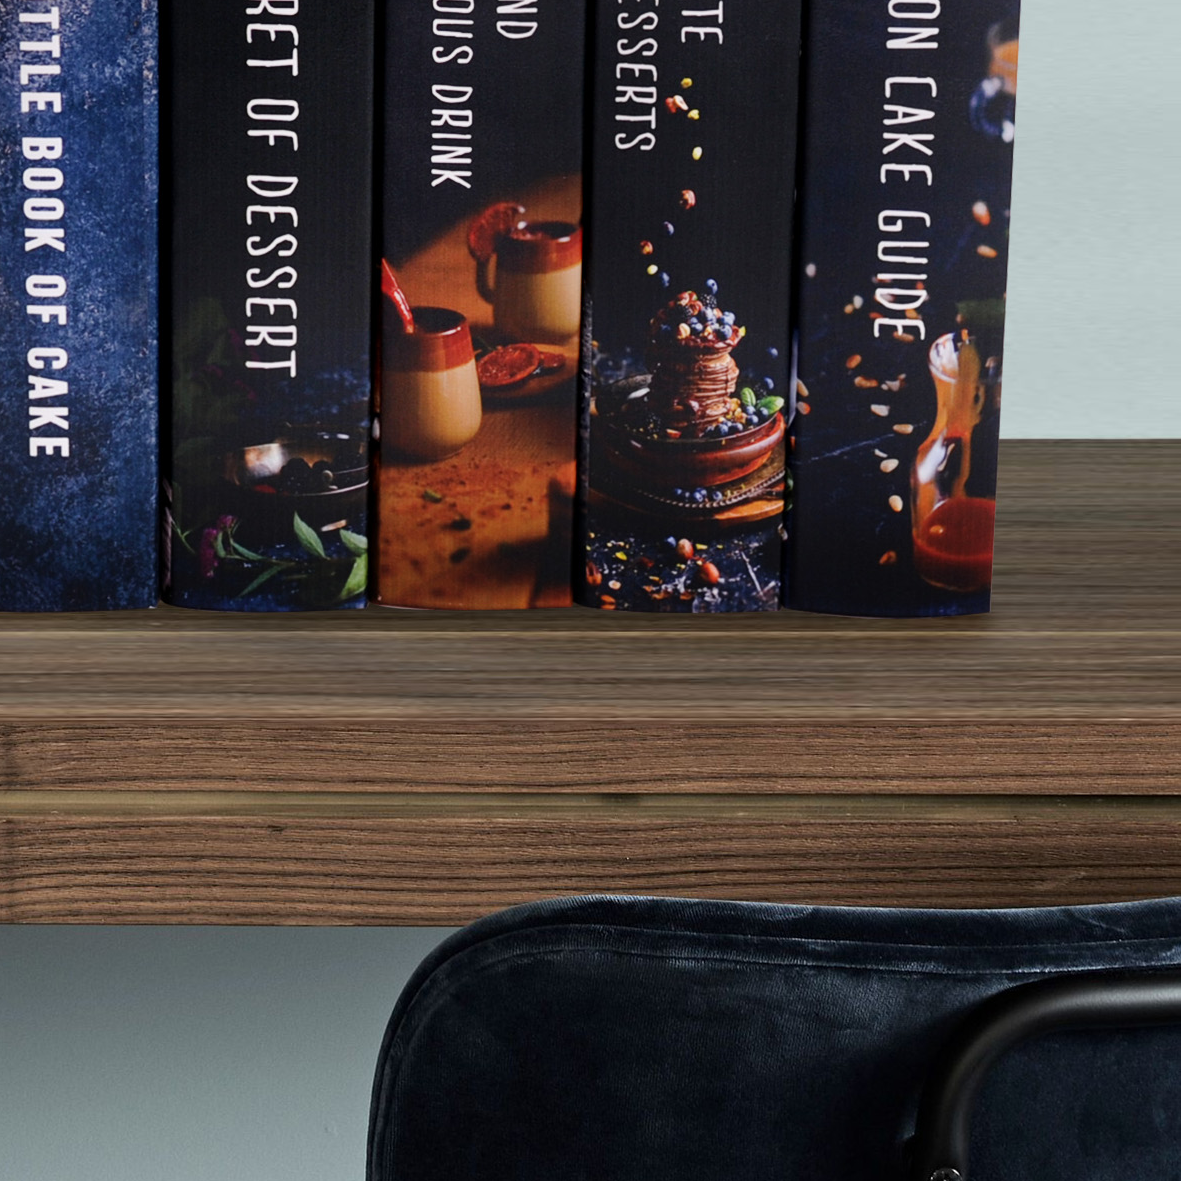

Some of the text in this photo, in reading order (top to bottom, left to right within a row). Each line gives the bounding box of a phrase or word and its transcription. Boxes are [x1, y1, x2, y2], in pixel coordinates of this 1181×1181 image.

[246, 98, 300, 151] OF
[430, 84, 474, 189] DRINK
[880, 76, 937, 186] CAKE
[21, 136, 66, 253] BOOK
[25, 274, 68, 326] OF
[244, 174, 299, 378] DESSERT
[873, 209, 931, 341] GUIDE
[26, 346, 70, 458] CAKE
